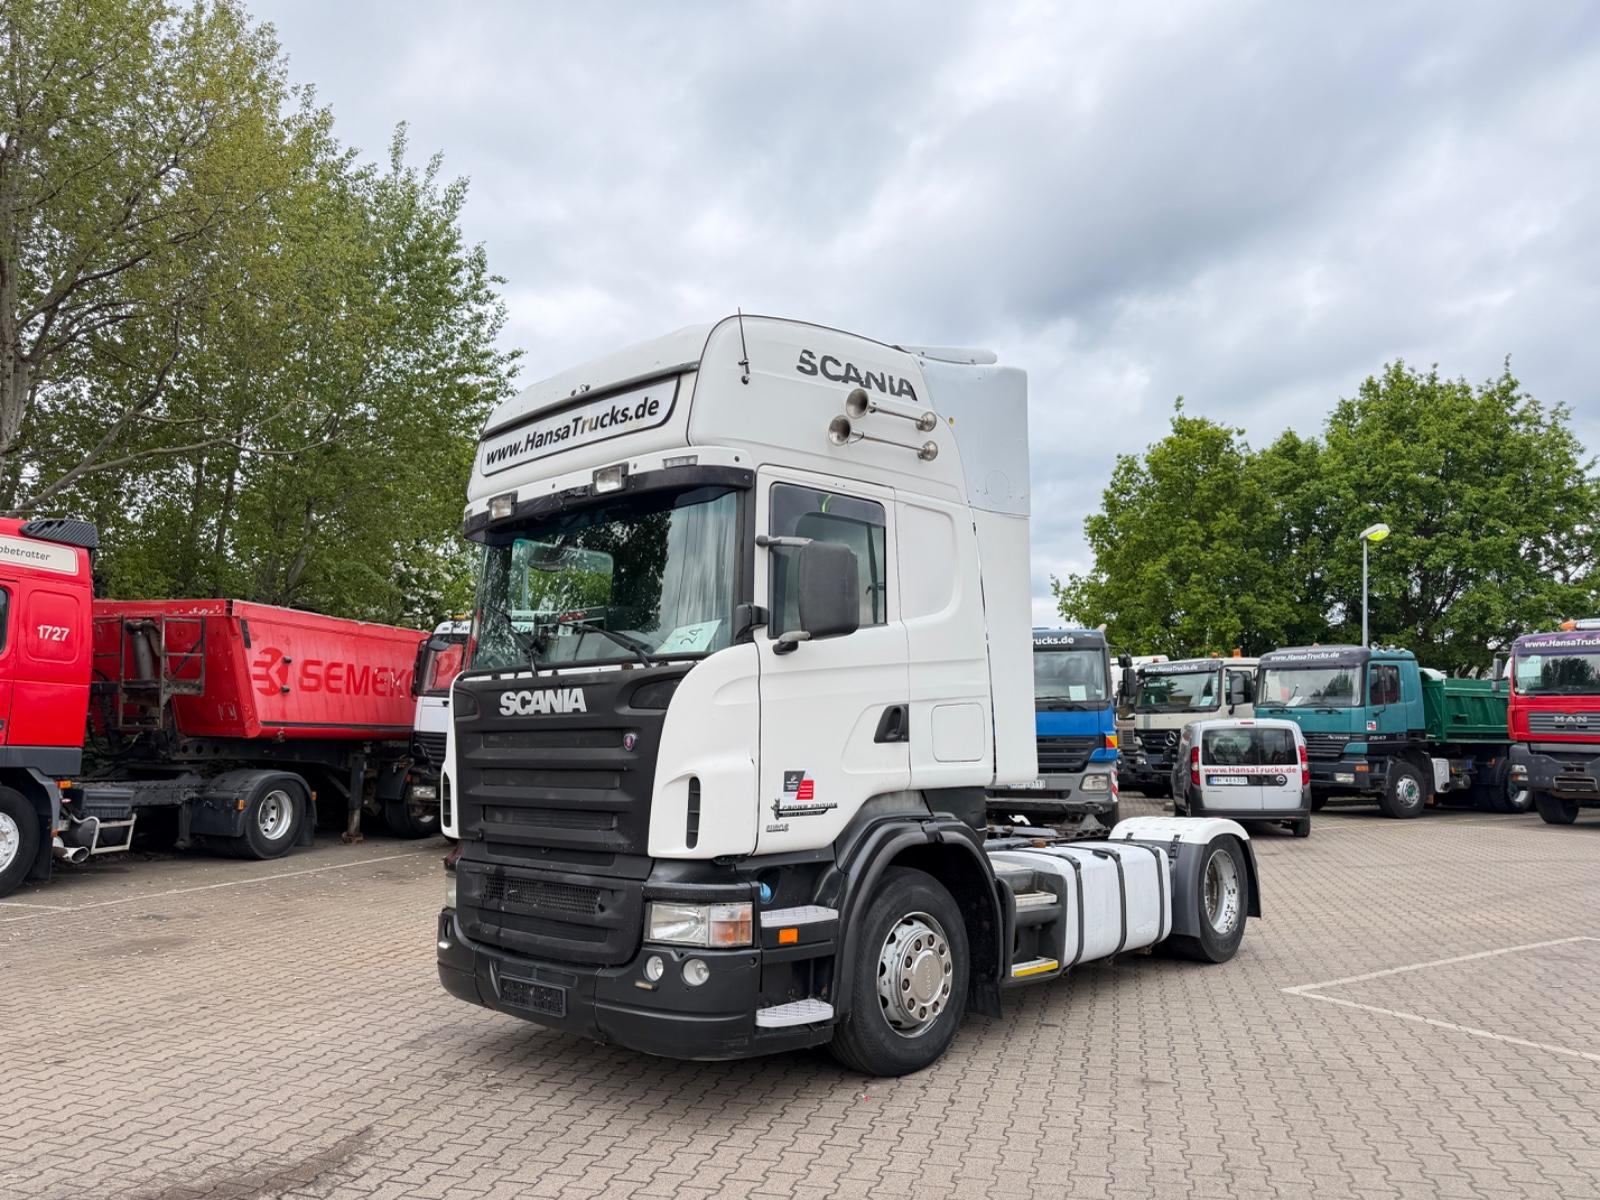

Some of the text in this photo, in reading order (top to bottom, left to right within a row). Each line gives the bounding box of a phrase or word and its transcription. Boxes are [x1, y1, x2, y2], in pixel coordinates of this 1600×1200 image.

[797, 349, 918, 401] SCANIA
[486, 397, 660, 465] www.HansaTrucks.de
[37, 625, 70, 642] 1727
[499, 687, 587, 716] SCANIA
[1553, 715, 1588, 723] MAN
[1204, 766, 1297, 774] www.HansaTrucks.de
